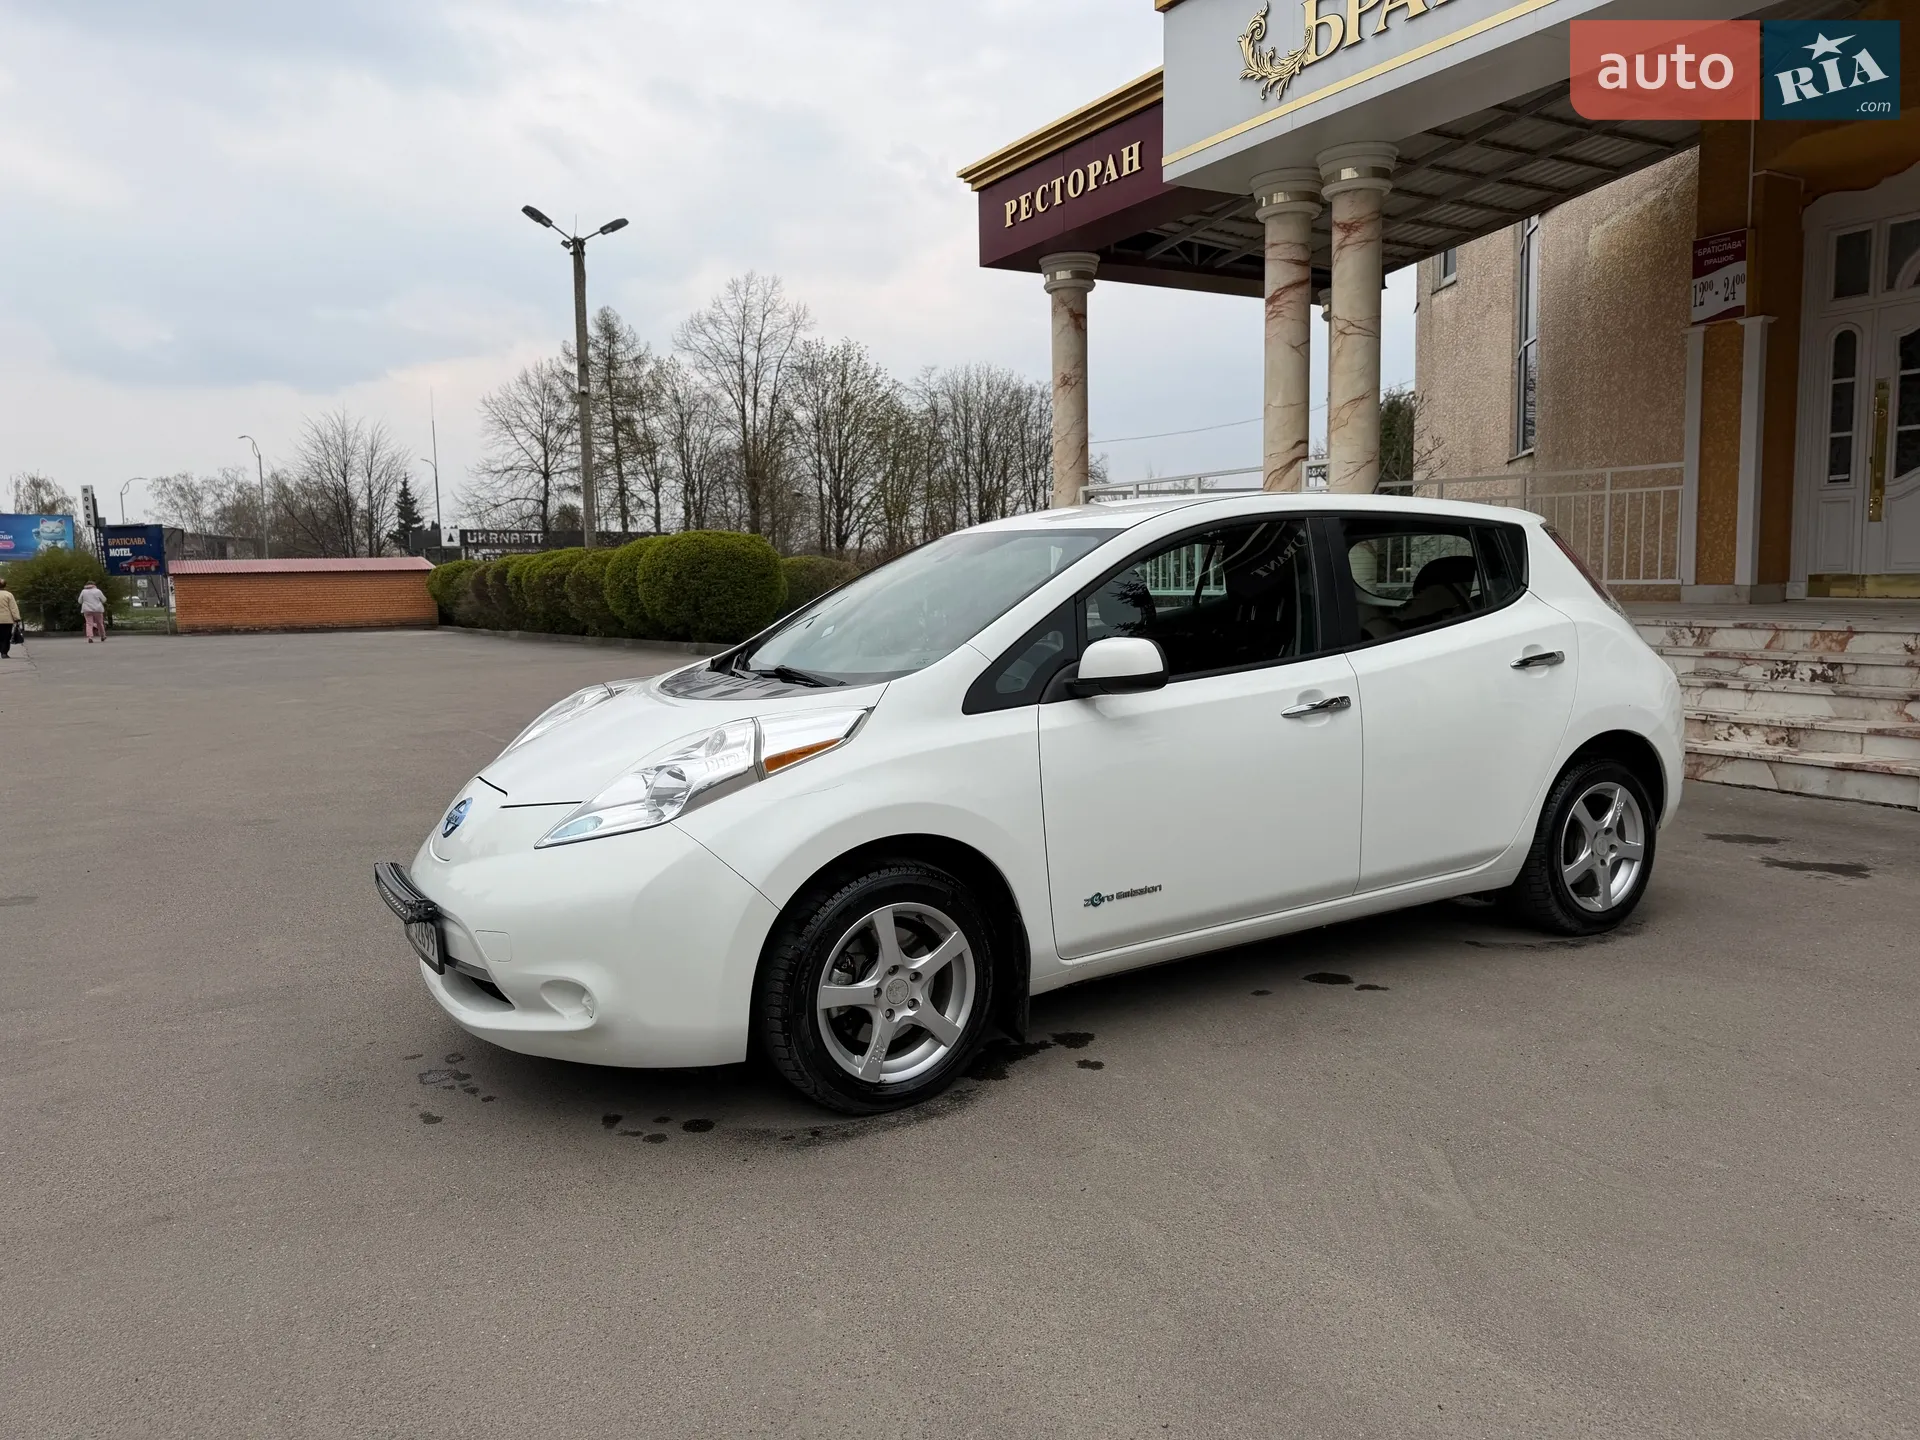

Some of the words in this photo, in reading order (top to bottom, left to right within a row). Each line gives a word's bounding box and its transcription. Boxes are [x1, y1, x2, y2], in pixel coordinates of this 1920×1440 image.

[1004, 140, 1143, 229] РЕСТОРАН
[109, 547, 133, 557] MOTEL
[1115, 884, 1162, 900] Emission
